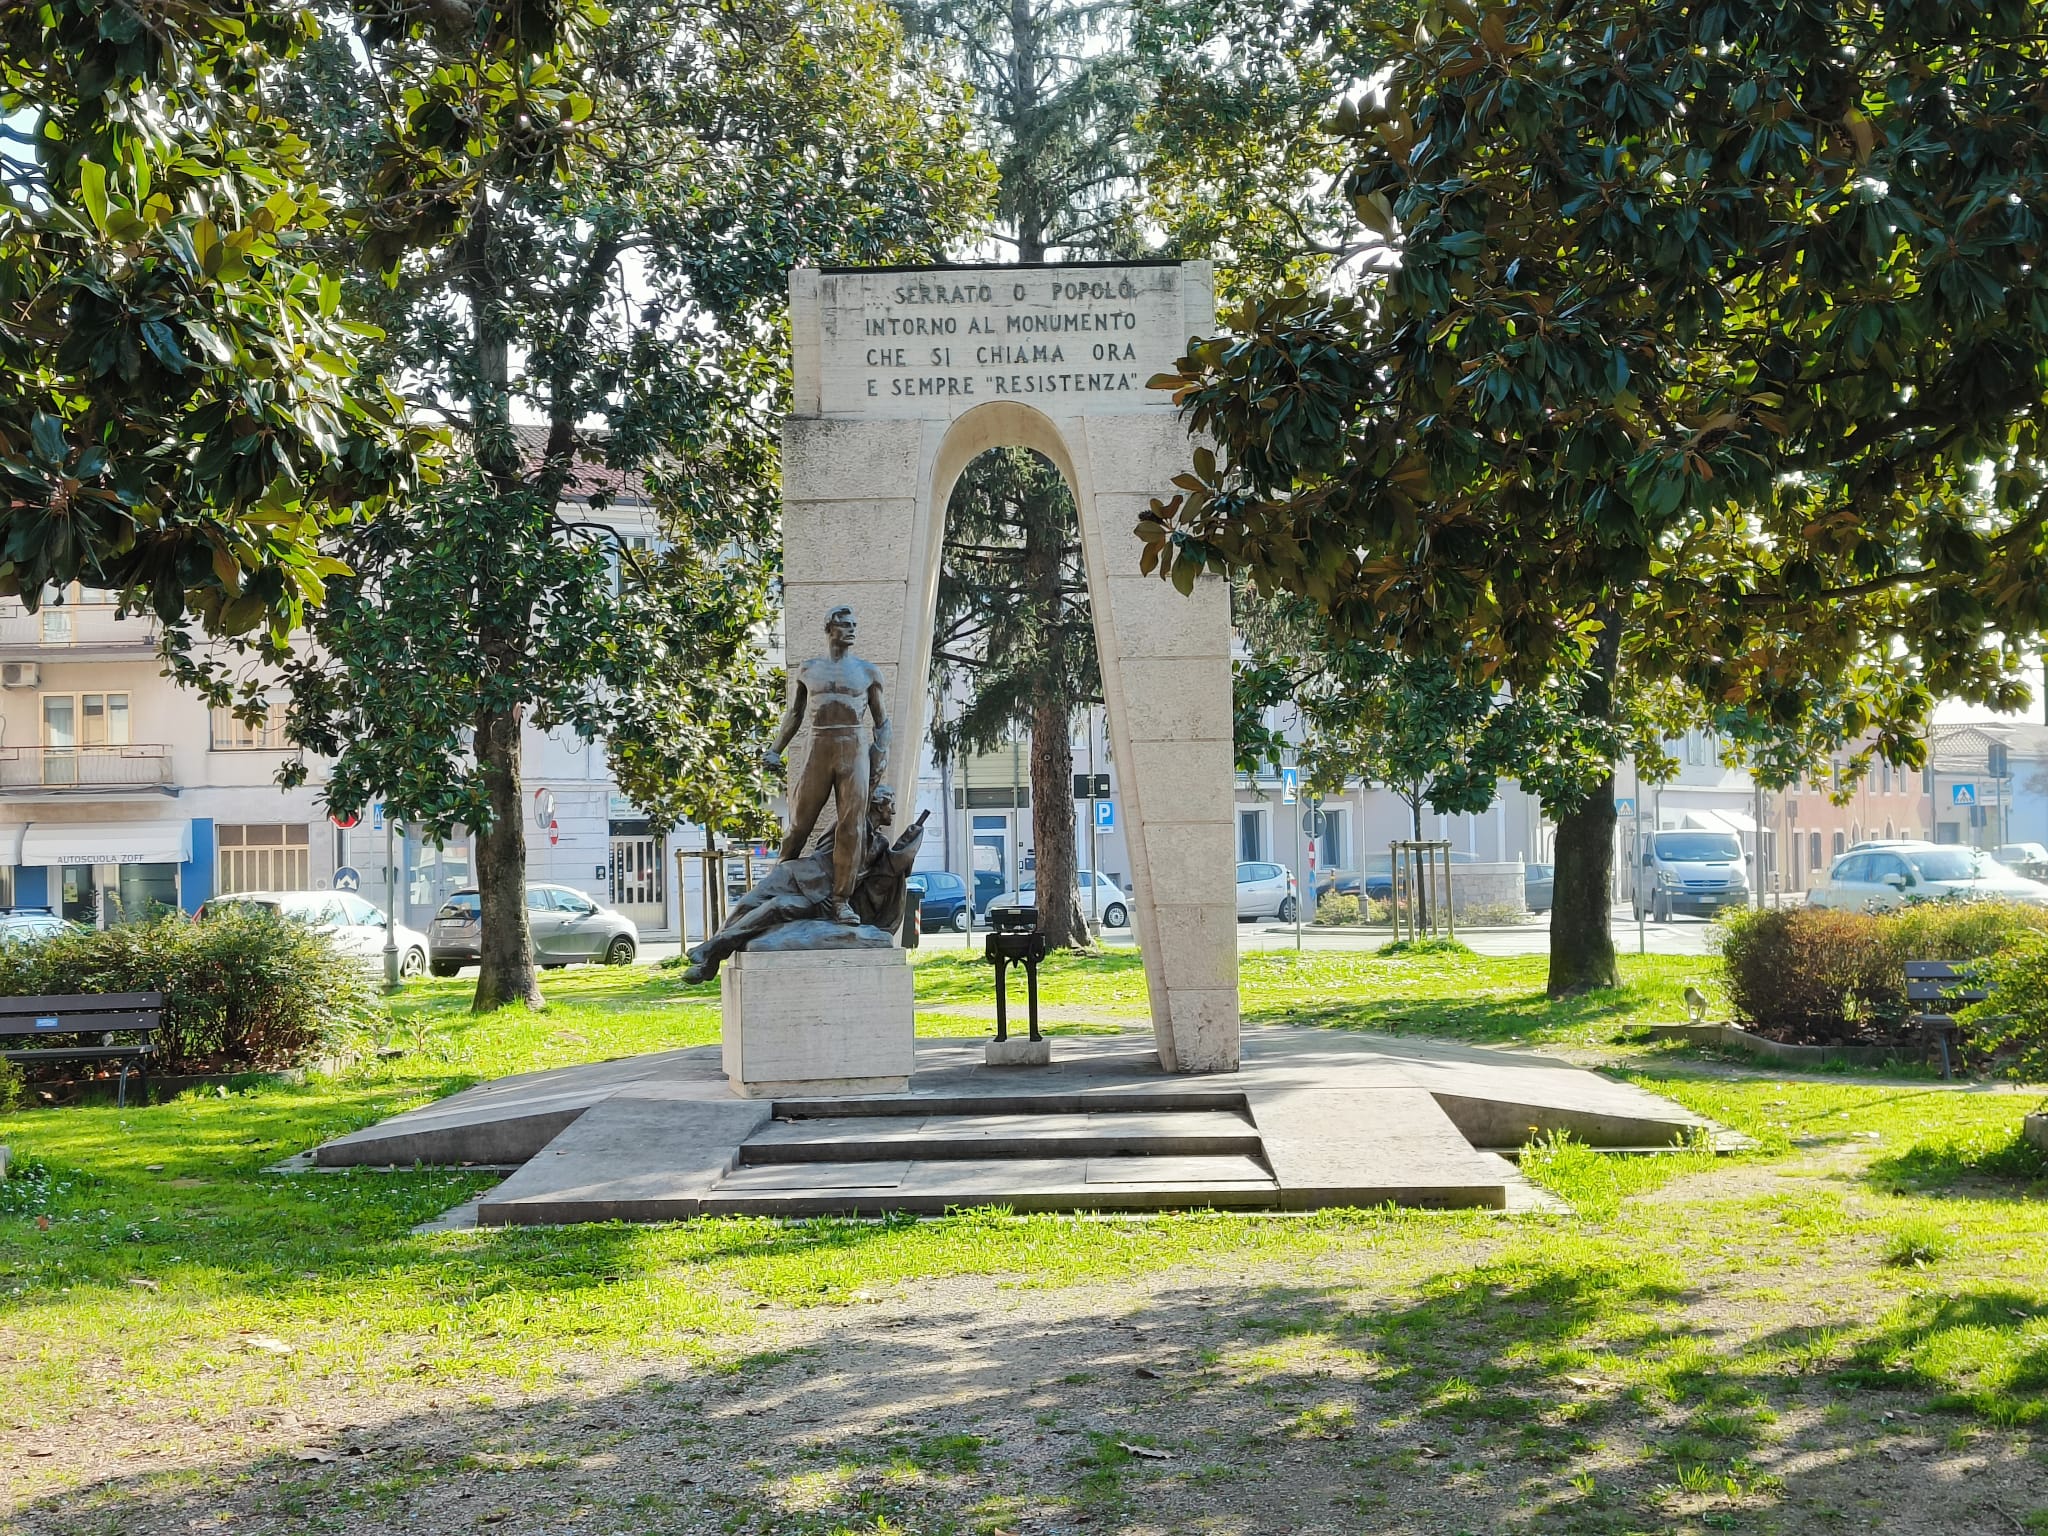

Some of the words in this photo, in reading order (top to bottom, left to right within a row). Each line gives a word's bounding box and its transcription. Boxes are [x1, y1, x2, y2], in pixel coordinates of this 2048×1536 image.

[894, 283, 992, 305] SERRATO
[1013, 283, 1025, 301] O
[866, 317, 957, 336] INTORNO
[968, 316, 995, 334] AL
[1006, 312, 1136, 333] MONUMENTO
[866, 348, 906, 367] CHE
[930, 347, 950, 367] SI
[976, 344, 1064, 364] CHIAMA
[1092, 342, 1136, 361] ORA
[867, 379, 878, 397] E
[891, 376, 974, 396] SEMPRE
[1099, 803, 1110, 823] P
[57, 855, 118, 864] AUTOSCUOLA
[121, 854, 144, 862] ZOFF
